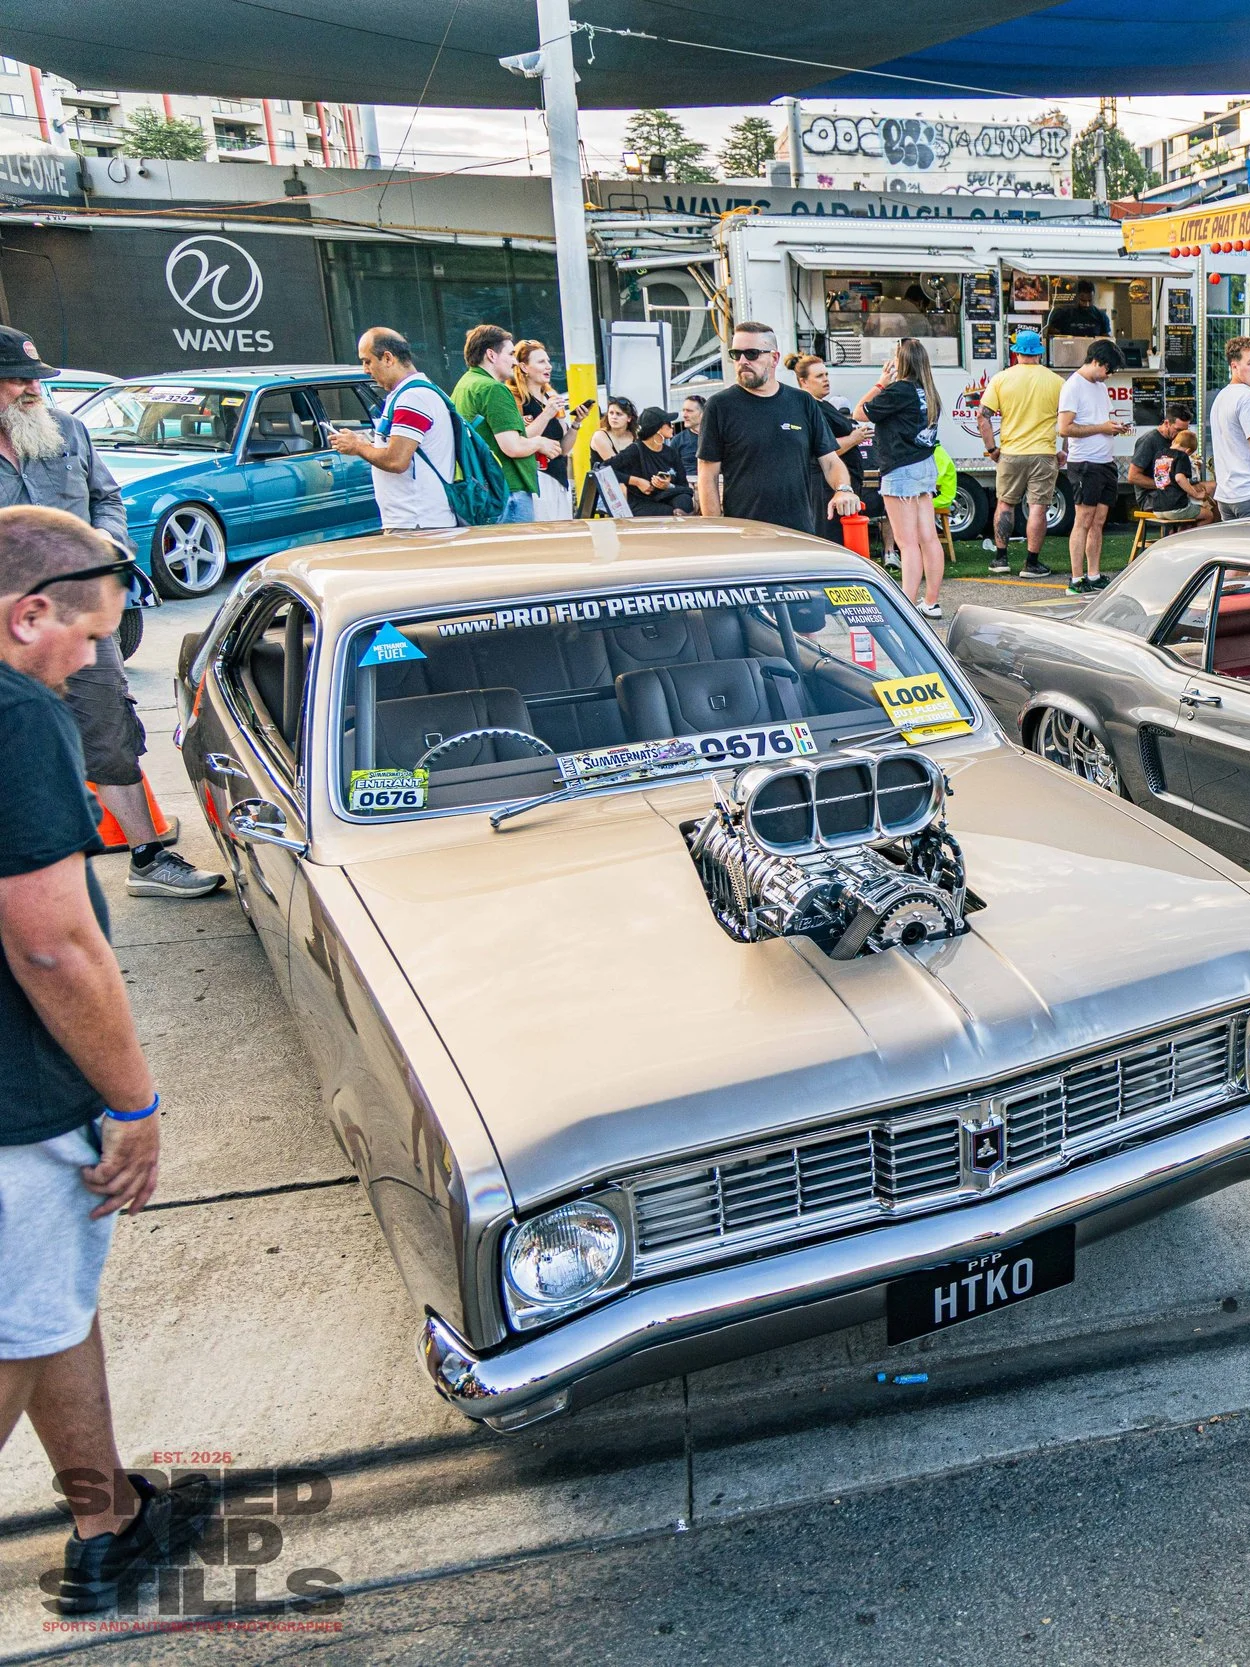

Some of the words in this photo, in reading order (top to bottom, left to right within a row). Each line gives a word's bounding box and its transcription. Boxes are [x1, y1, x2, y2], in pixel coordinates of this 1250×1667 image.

[0, 155, 70, 198] ELCOME
[1179, 216, 1210, 243] LITTLE
[1211, 213, 1238, 239] PHAT
[172, 328, 274, 353] WAVES
[165, 395, 195, 403] 3292
[952, 410, 971, 418] P&J
[829, 588, 871, 603] CRUISING
[438, 606, 549, 637] www.PRO
[554, 600, 601, 624] FLO
[607, 586, 811, 618] PERFORMANCE.com
[840, 606, 882, 616] METHANOL
[847, 615, 884, 624] MADNESS
[373, 641, 408, 652] METHANOL
[377, 648, 406, 660] FUEL
[883, 682, 946, 707] LOOK
[893, 708, 914, 719] BUT
[914, 701, 951, 714] PLEASE
[582, 747, 659, 771] SUMMERNATS
[699, 729, 795, 764] 0676
[356, 778, 421, 788] ENTRANT
[359, 790, 417, 807] 0676
[967, 1252, 1002, 1272] PFP
